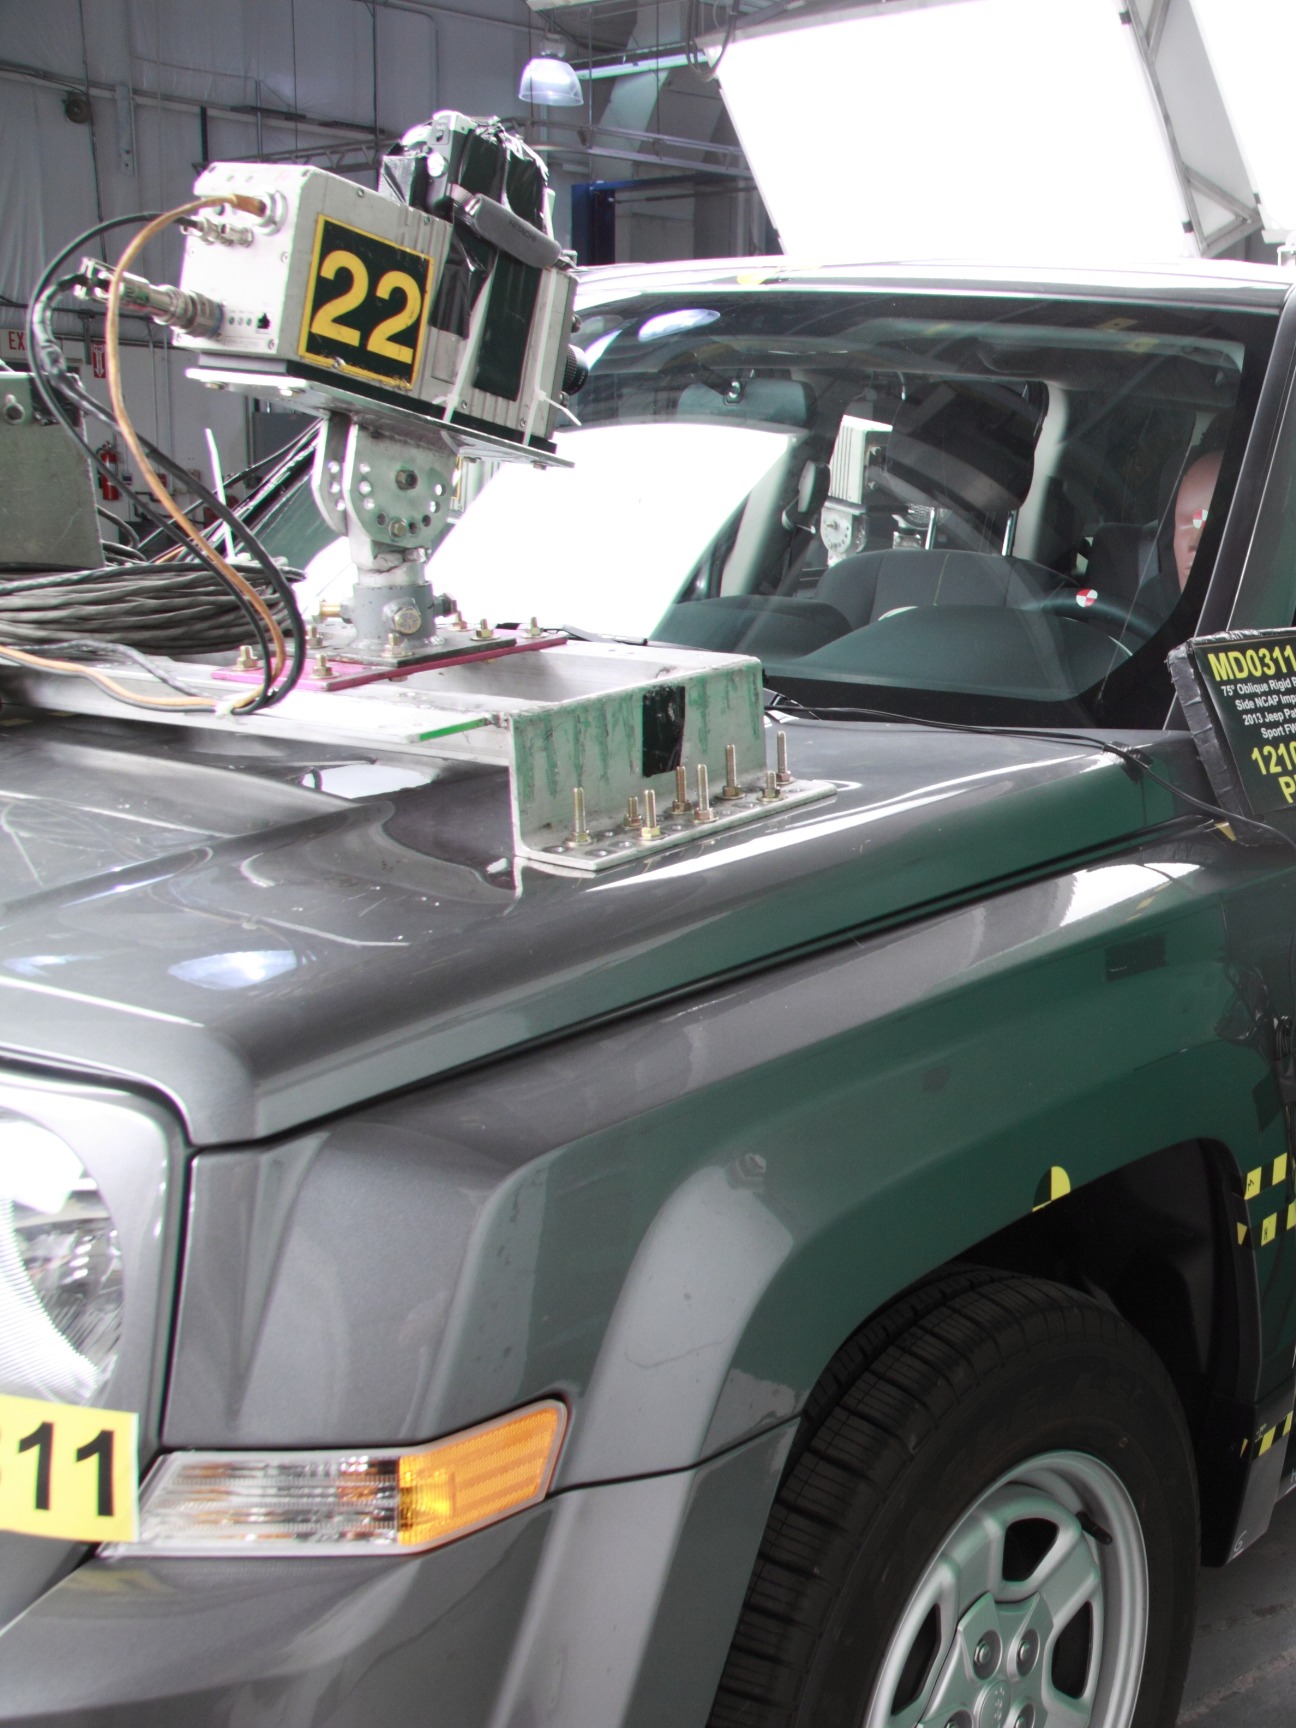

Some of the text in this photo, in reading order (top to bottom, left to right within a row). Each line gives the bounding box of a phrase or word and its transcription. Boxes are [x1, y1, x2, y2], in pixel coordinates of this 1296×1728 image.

[310, 250, 421, 365] 22
[1236, 682, 1269, 695] Oblique
[1268, 678, 1292, 692] Rigid
[1235, 700, 1255, 711] Side
[1254, 695, 1279, 708] NCAP
[1242, 713, 1263, 726] 2013
[1264, 711, 1284, 723] Jeep
[1260, 726, 1285, 740] Sport
[16, 1420, 115, 1517] 11
